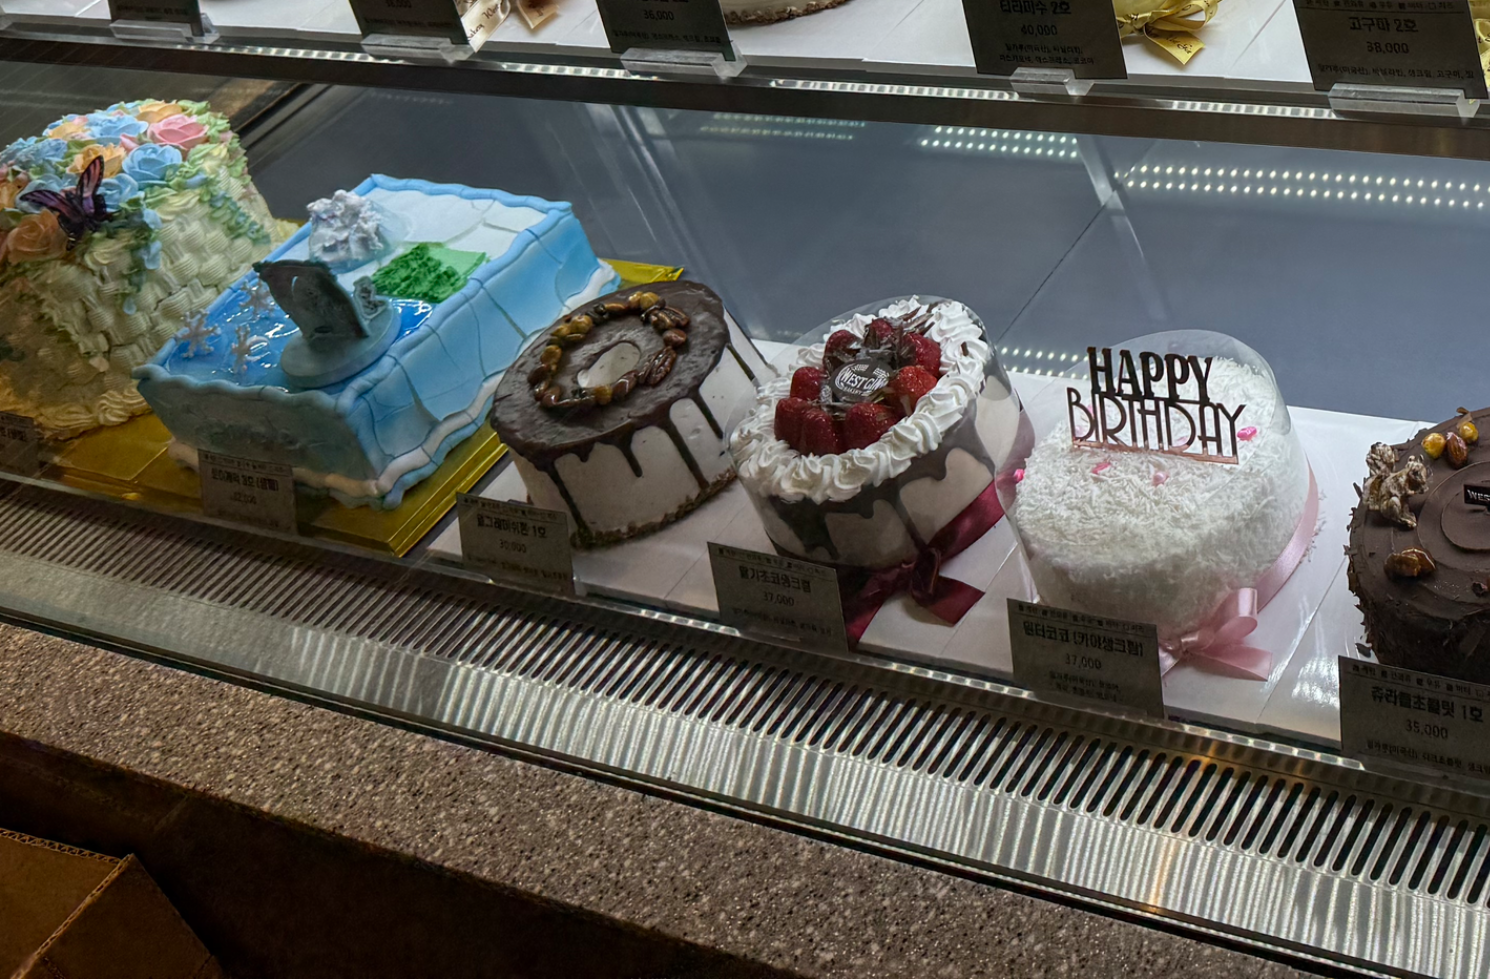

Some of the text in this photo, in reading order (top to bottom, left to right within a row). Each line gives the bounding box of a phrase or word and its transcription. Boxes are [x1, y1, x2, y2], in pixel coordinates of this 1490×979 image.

[642, 8, 676, 22] 36,000
[1051, 0, 1073, 16] 2호
[1020, 23, 1058, 38] 40,000
[1349, 15, 1420, 34] 고구마 2호
[1365, 40, 1411, 55] 38,000
[839, 369, 889, 392] WEST GIN
[1086, 346, 1214, 403] HAPPY
[1066, 386, 1247, 462] BIRTHDAY
[476, 513, 548, 540] 얼그레이쉬폰 1호
[738, 565, 812, 594] 딸기초코생크림
[762, 590, 795, 607] 37,000
[1022, 620, 1070, 644] 윈터코코
[1064, 652, 1103, 670] 37,000
[1460, 704, 1484, 723] 1호
[1404, 718, 1450, 741] 35,000
